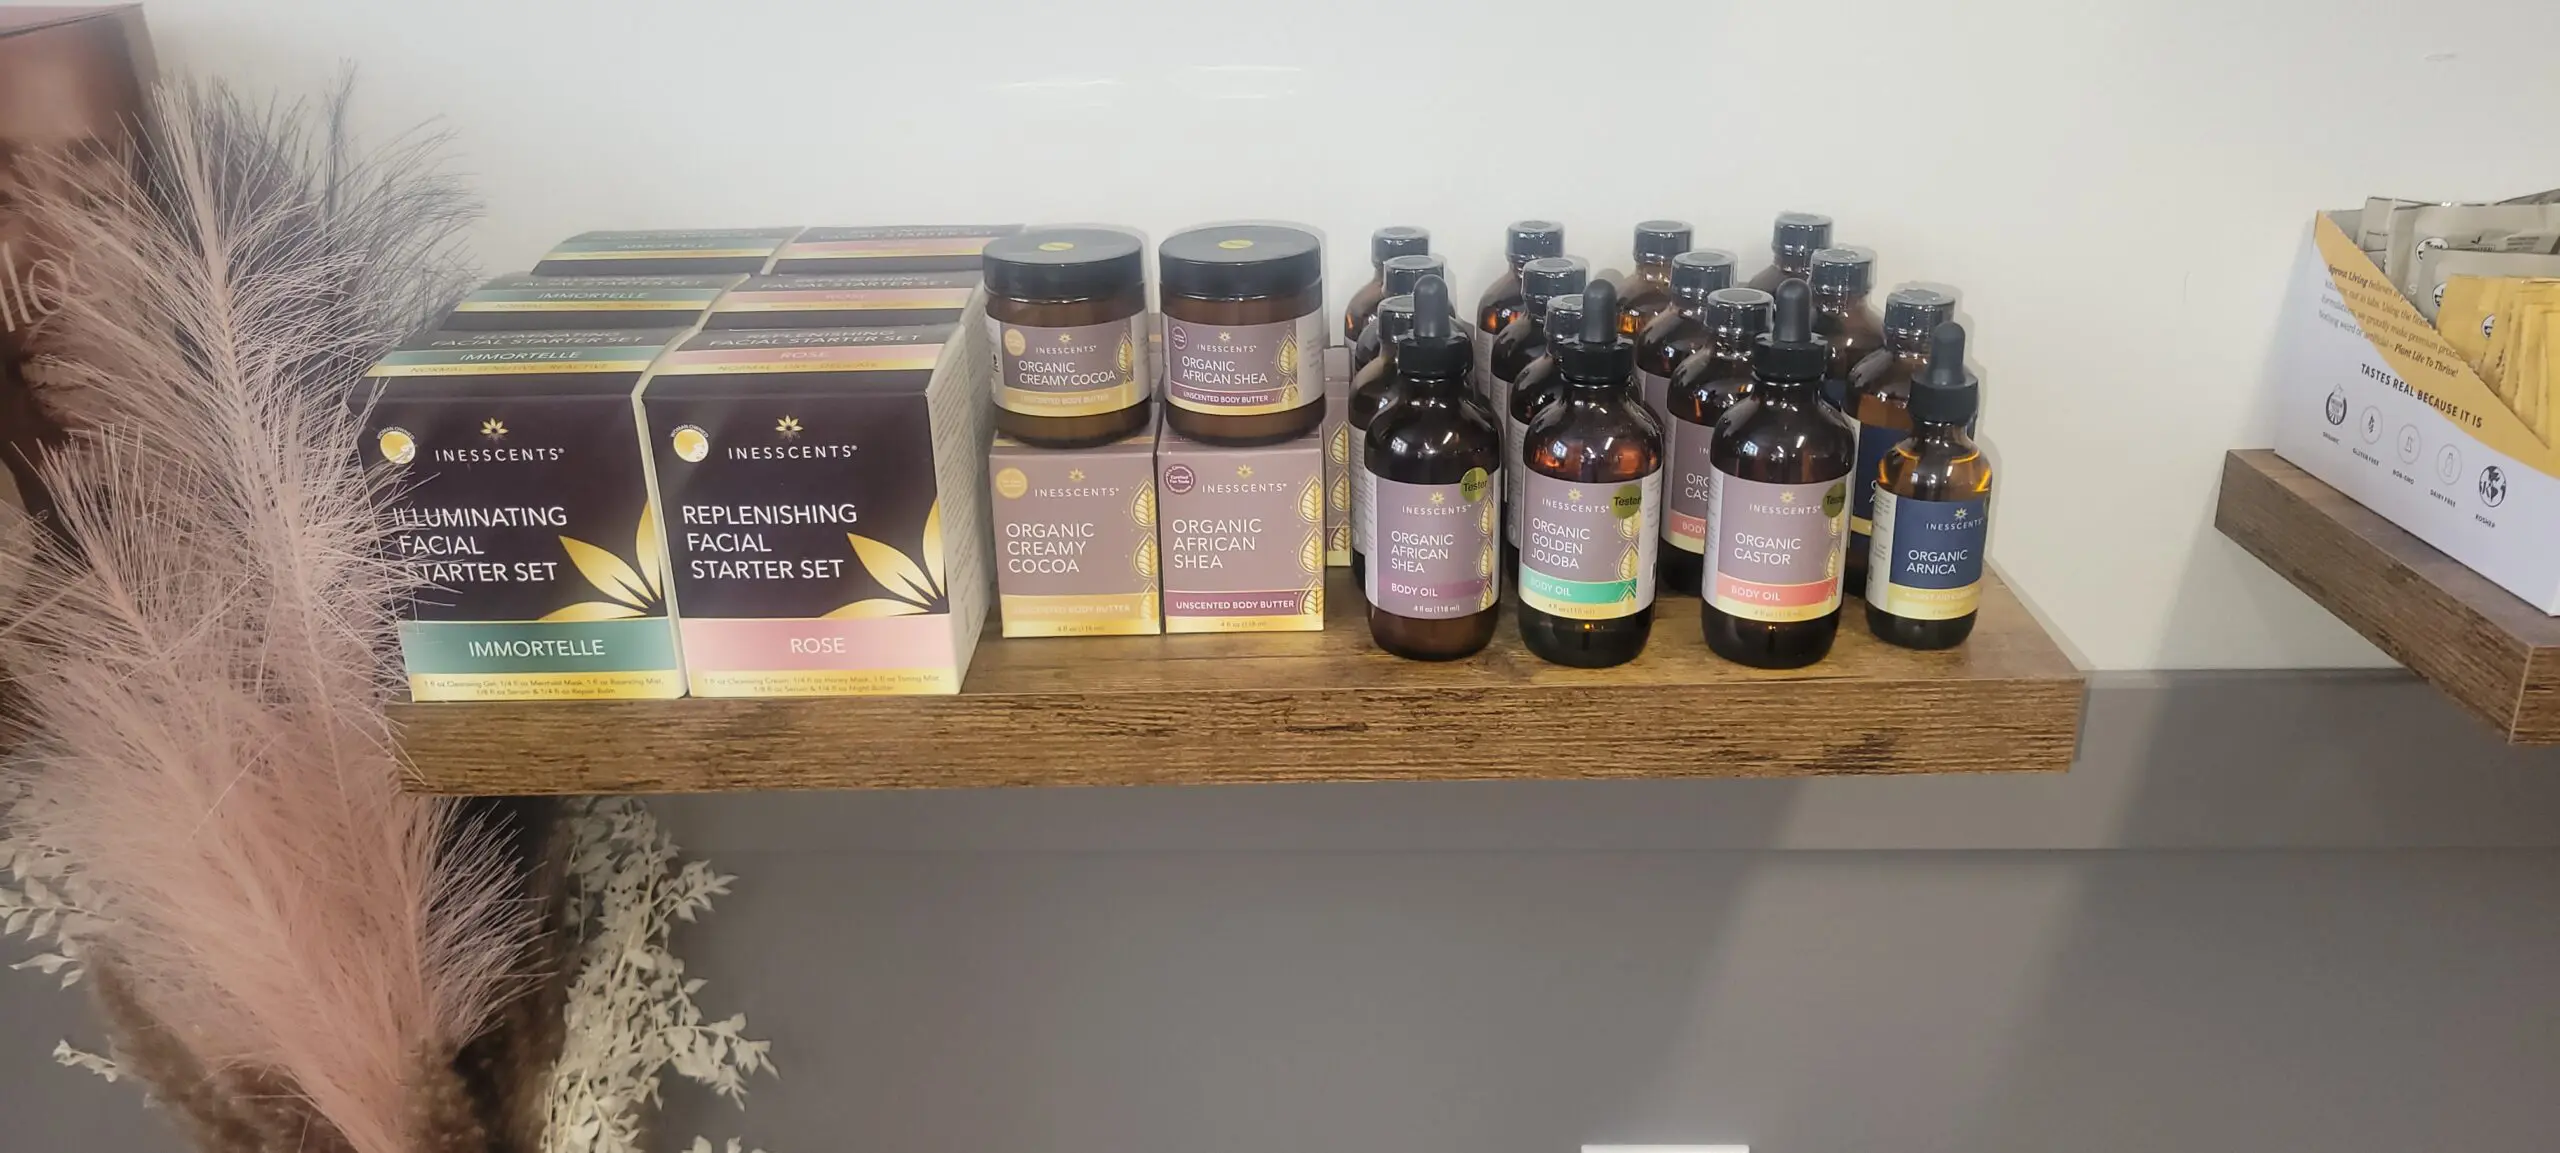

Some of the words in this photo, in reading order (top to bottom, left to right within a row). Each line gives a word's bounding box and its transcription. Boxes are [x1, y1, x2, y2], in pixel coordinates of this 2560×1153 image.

[2347, 270, 2369, 289] Living
[431, 338, 503, 347] FACIAL
[509, 337, 602, 346] STARTER
[606, 335, 645, 344] SET
[709, 338, 781, 347] FACIAL
[788, 336, 878, 345] STARTER
[883, 333, 922, 343] SET
[459, 350, 583, 361] IMMORTELLE
[2394, 342, 2412, 359] Plant
[2412, 351, 2426, 363] Life
[2425, 355, 2434, 367] To
[1018, 360, 1076, 374] ORGANIC
[1181, 355, 1236, 373] ORGANIC
[1019, 372, 1069, 387] CREAMY
[1070, 370, 1117, 386] COCOA
[1182, 368, 1232, 386] AFRICAN
[1234, 372, 1269, 385] SHEA
[1183, 391, 1220, 403] UNSCENTED
[1220, 395, 1241, 404] BODY
[1241, 394, 1269, 404] BUTTER
[2361, 362, 2390, 386] TASTES
[2393, 378, 2415, 398] REAL
[2416, 389, 2457, 418] BECAUSE
[2459, 410, 2471, 424] IT
[2471, 416, 2483, 429] IS
[1463, 479, 1489, 492] Tester
[393, 506, 568, 528] ILLUMINATING
[682, 503, 858, 525] REPLENISHING
[1005, 522, 1095, 538] ORGANIC
[1172, 518, 1263, 534] ORGANIC
[1532, 517, 1591, 541] ORGANIC
[400, 535, 485, 555] FACIAL
[687, 533, 773, 552] FACIAL
[1173, 536, 1256, 551] AFRICAN
[1391, 530, 1454, 546] ORGANIC
[1531, 532, 1583, 555] GOLDEN
[1735, 532, 1802, 550] ORGANIC
[1007, 540, 1087, 556] CREAMY
[1391, 544, 1449, 560] AFRICAN
[1734, 547, 1791, 565] CASTOR
[1908, 549, 1969, 563] ORGANIC
[1008, 558, 1080, 574] COCOA
[1174, 554, 1223, 569] SHEA
[1391, 557, 1426, 574] SHEA
[1531, 547, 1580, 569] JOJOBA
[405, 562, 510, 583] STARTER
[515, 562, 558, 582] SET
[691, 559, 795, 579] STARTER
[800, 559, 845, 579] SET
[1906, 562, 1957, 575] ARNICA
[1391, 582, 1418, 597] BODY
[1420, 587, 1439, 597] OIL
[1555, 585, 1572, 597] OIL
[1731, 584, 1760, 599] BODY
[1762, 590, 1781, 601] OIL
[1176, 601, 1231, 610] UNSCENTED
[1232, 601, 1258, 610] BODY
[1260, 599, 1295, 609] BUTTER
[468, 639, 607, 658] IMMORTELLE
[790, 637, 847, 654] ROSE
